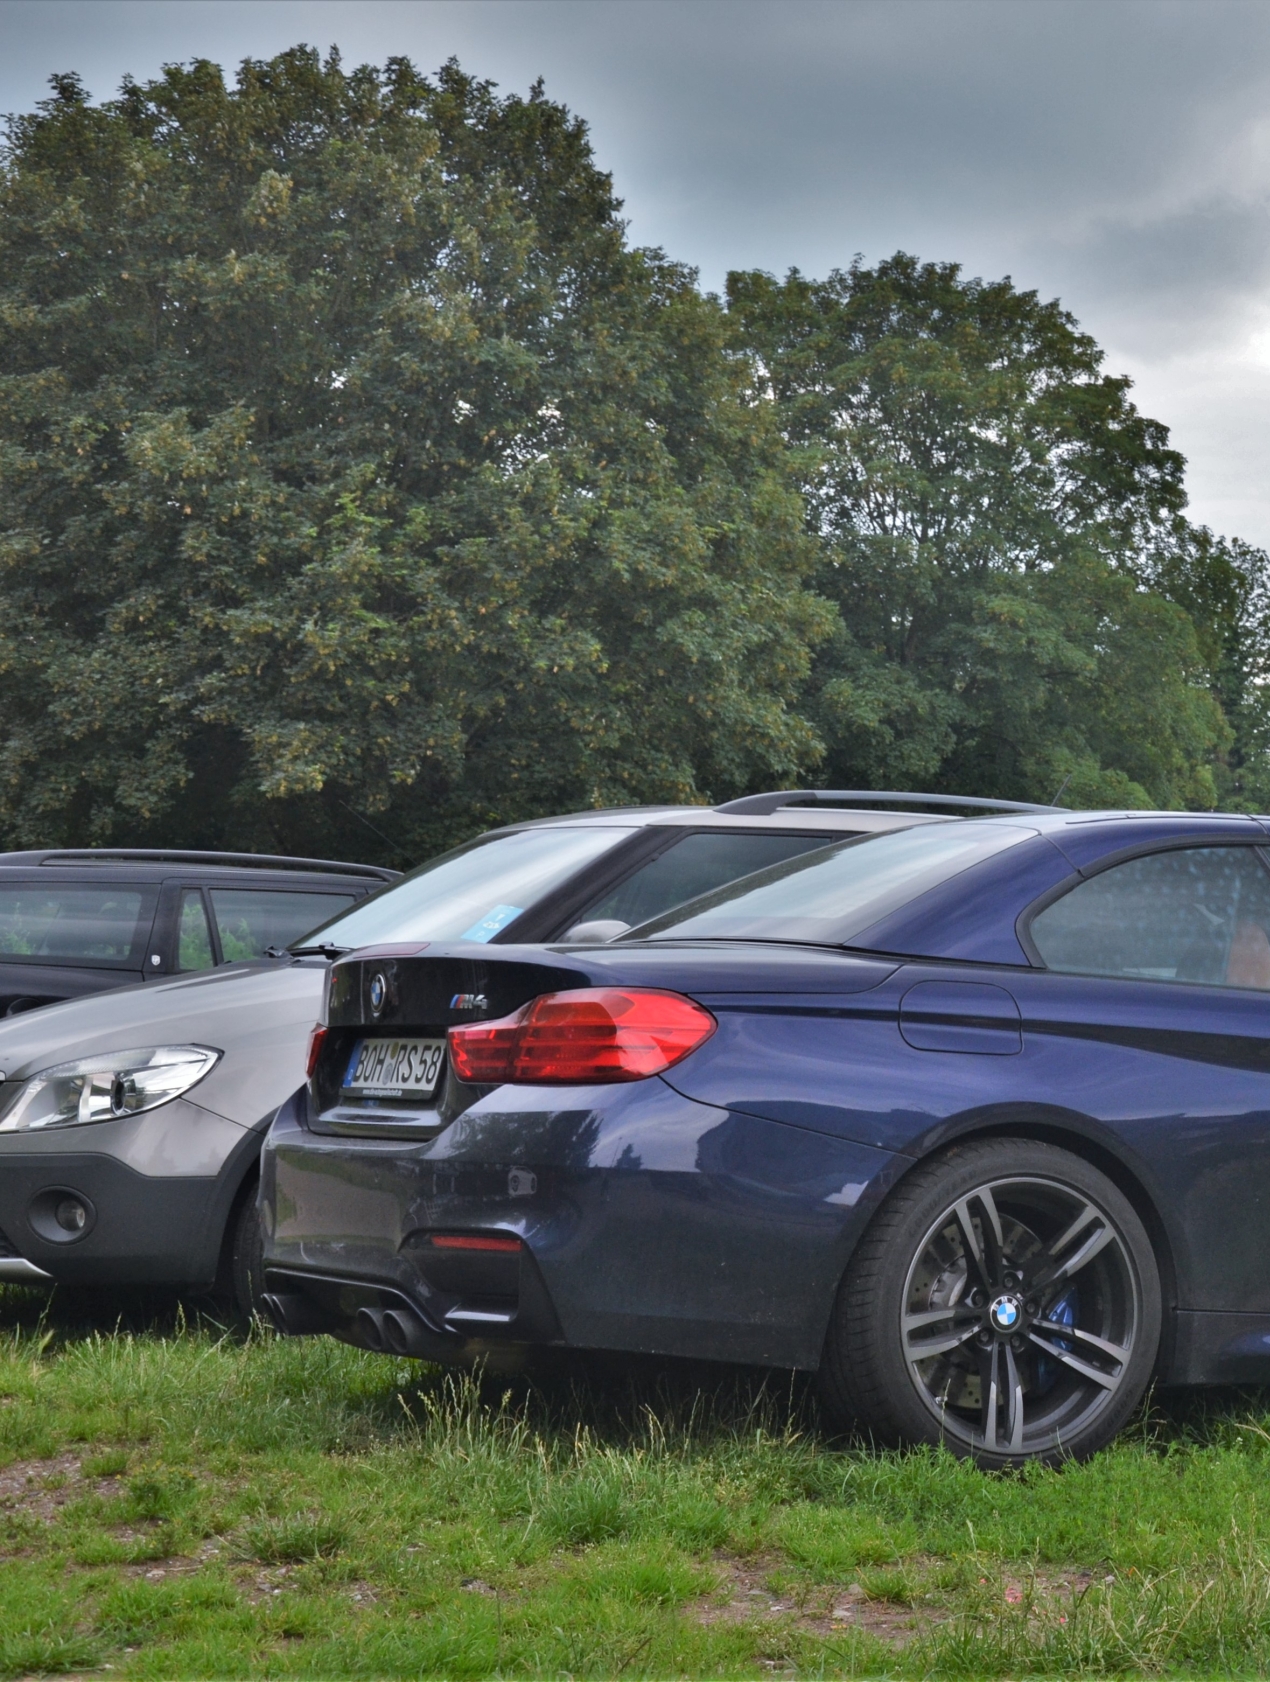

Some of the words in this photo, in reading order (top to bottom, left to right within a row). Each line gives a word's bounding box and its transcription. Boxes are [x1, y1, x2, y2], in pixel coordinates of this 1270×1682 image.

[353, 1044, 390, 1083] BOH
[390, 1044, 418, 1084] RS
[414, 1044, 442, 1085] 58
